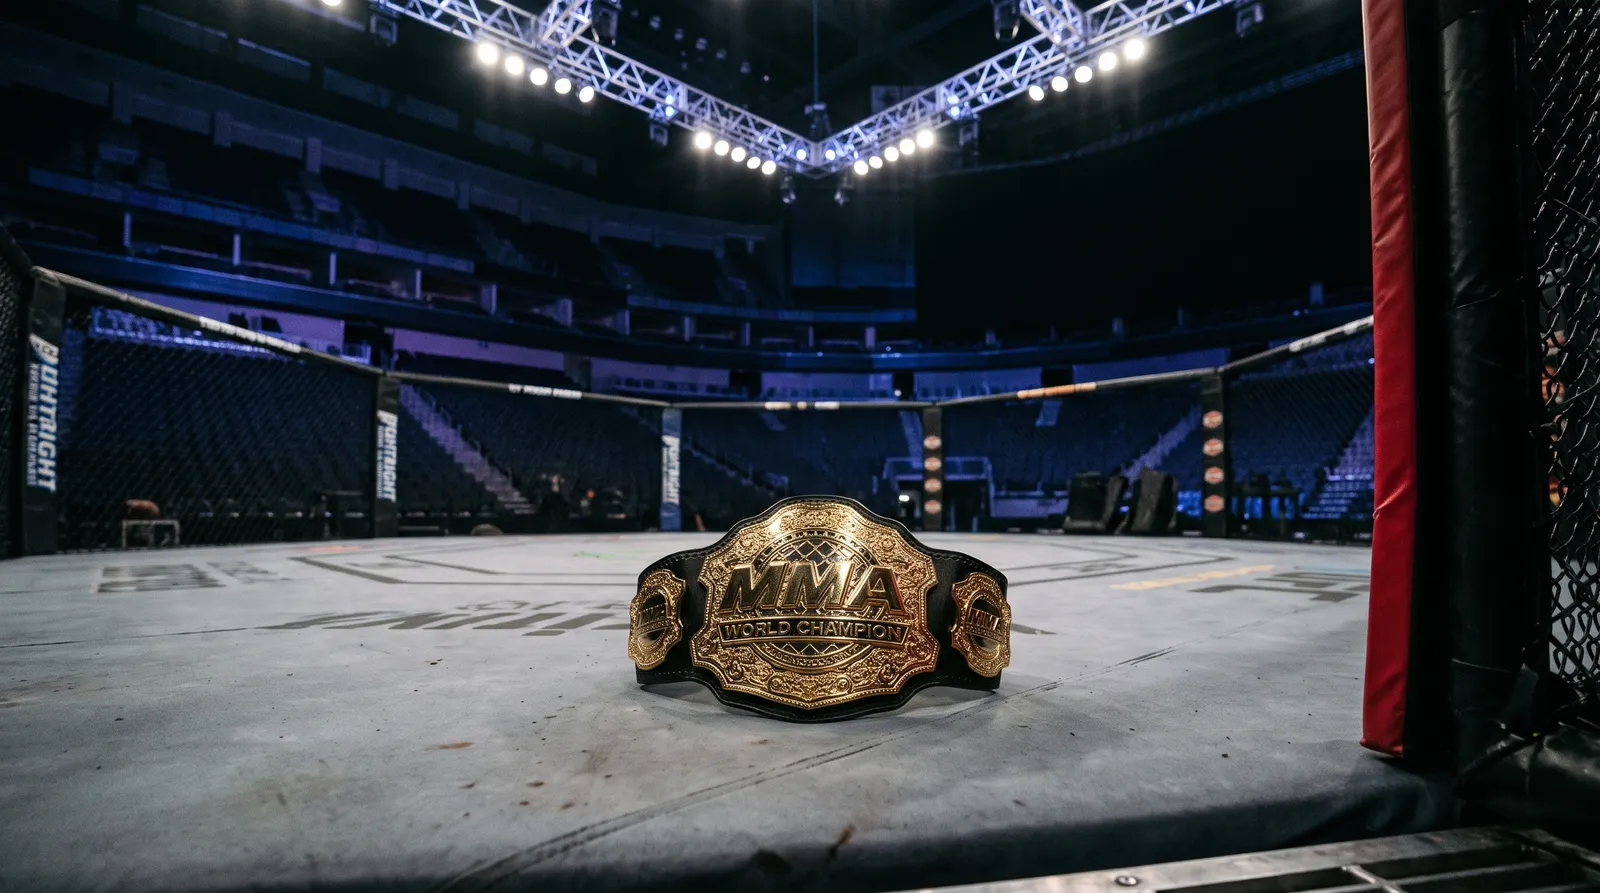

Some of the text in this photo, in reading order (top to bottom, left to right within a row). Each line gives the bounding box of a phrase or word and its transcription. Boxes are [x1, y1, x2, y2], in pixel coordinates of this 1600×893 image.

[718, 560, 908, 615] MMA
[724, 620, 902, 641] WORLD CHAMPION
